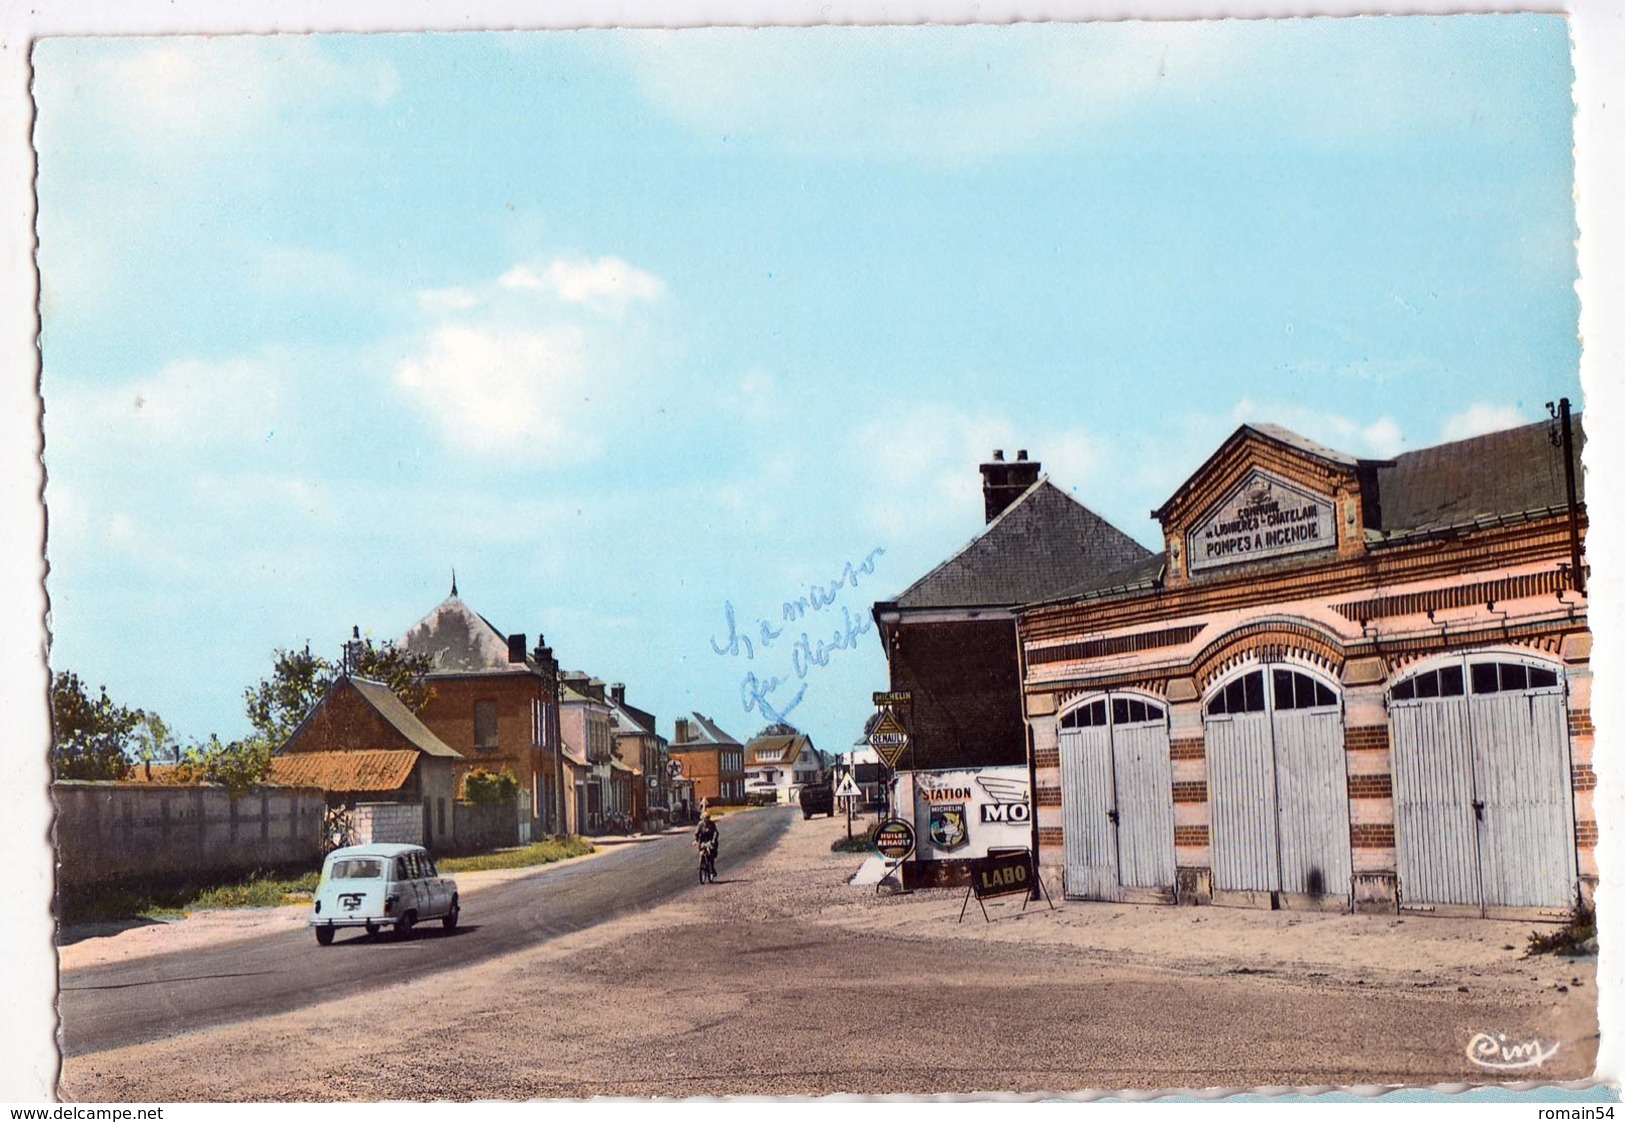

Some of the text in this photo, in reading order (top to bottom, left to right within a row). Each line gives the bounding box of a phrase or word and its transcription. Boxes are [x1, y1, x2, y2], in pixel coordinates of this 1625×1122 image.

[1237, 501, 1280, 520] COMMUNE
[1206, 522, 1319, 557] POMPES A INCENDIE
[876, 691, 911, 701] MICHELIN
[872, 732, 904, 744] RENAULT
[922, 787, 971, 800] STATION
[984, 804, 1029, 821] MO
[981, 864, 1026, 888] LABO
